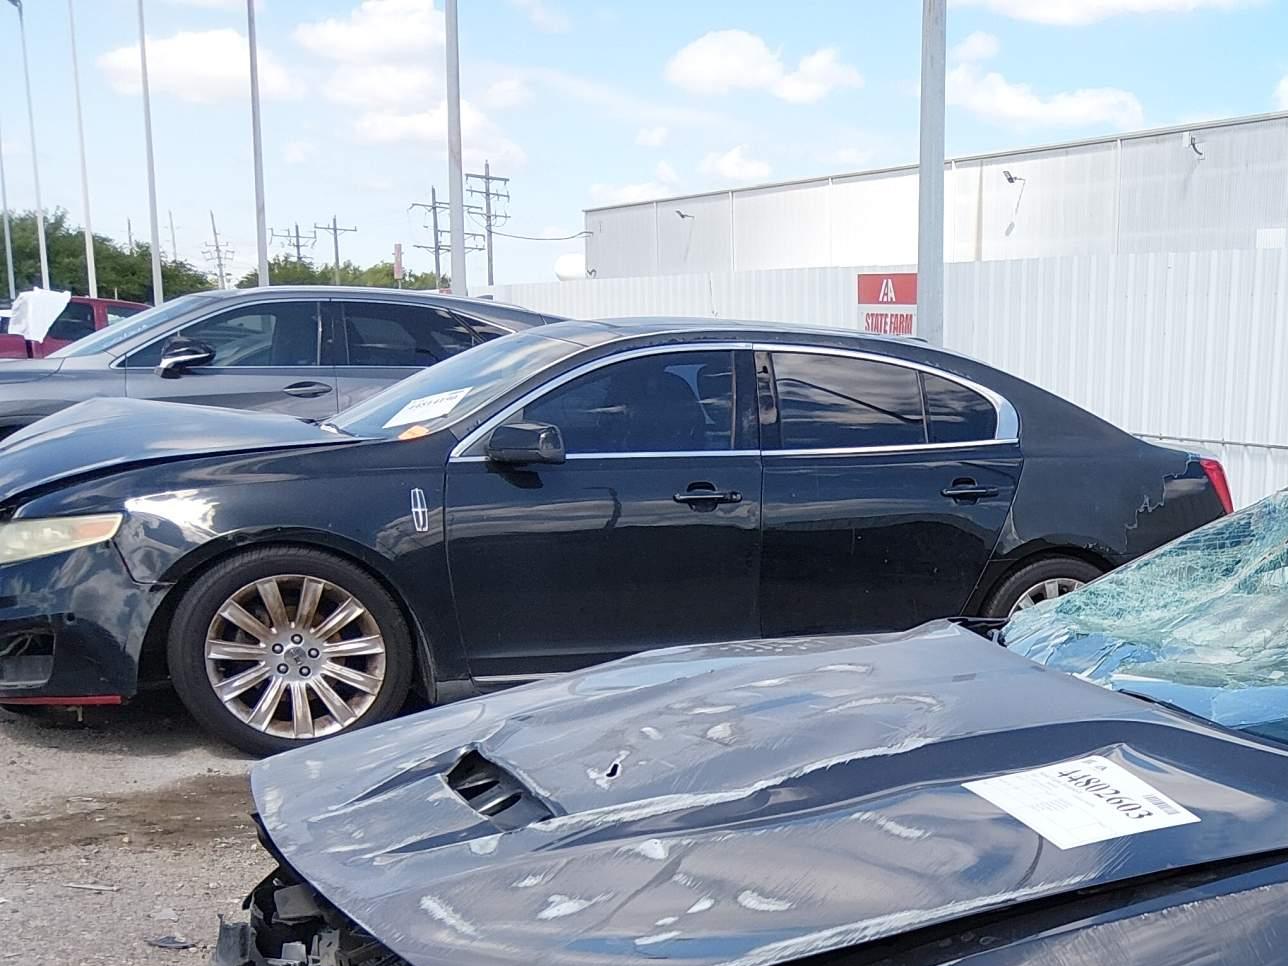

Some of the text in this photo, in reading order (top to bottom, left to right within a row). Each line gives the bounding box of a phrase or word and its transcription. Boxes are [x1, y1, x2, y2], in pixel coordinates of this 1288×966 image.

[864, 312, 913, 335] STATE FARM
[1056, 768, 1154, 820] 44802603
